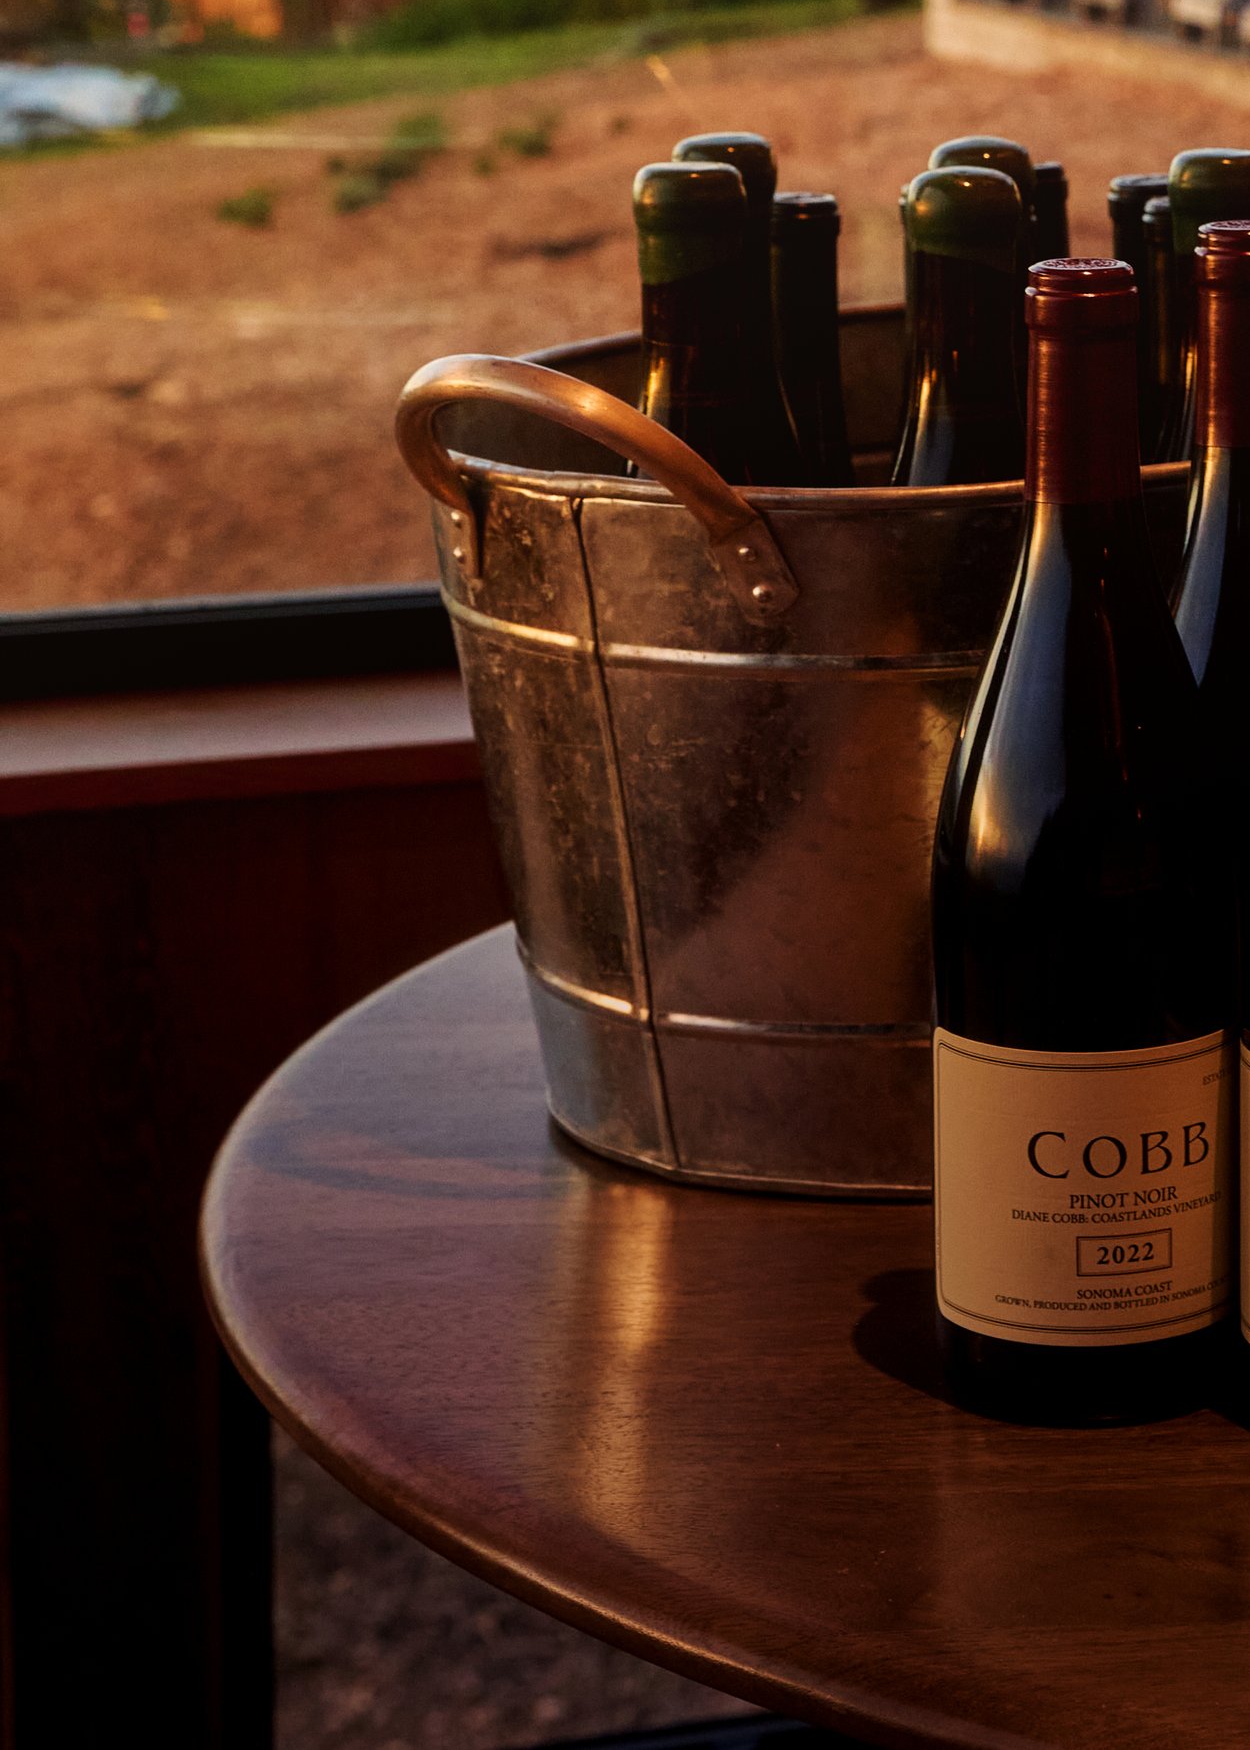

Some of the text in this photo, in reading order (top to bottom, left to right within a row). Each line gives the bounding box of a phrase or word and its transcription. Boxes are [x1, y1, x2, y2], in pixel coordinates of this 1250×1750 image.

[1027, 1121, 1209, 1179] COBB
[1012, 1191, 1222, 1224] DIANE COBB: COASTLANDS VINEYARD
[1069, 1186, 1179, 1209] PINOT NOIR
[1096, 1242, 1155, 1265] 2022
[995, 1294, 1032, 1308] GROWN,
[1033, 1299, 1087, 1311] PRODUCED
[1089, 1301, 1111, 1311] AND
[1113, 1296, 1158, 1310] BOTTLED
[1160, 1294, 1170, 1304] IN
[1171, 1284, 1206, 1302] SONOMA
[1076, 1280, 1174, 1300] SONOMA COAST
